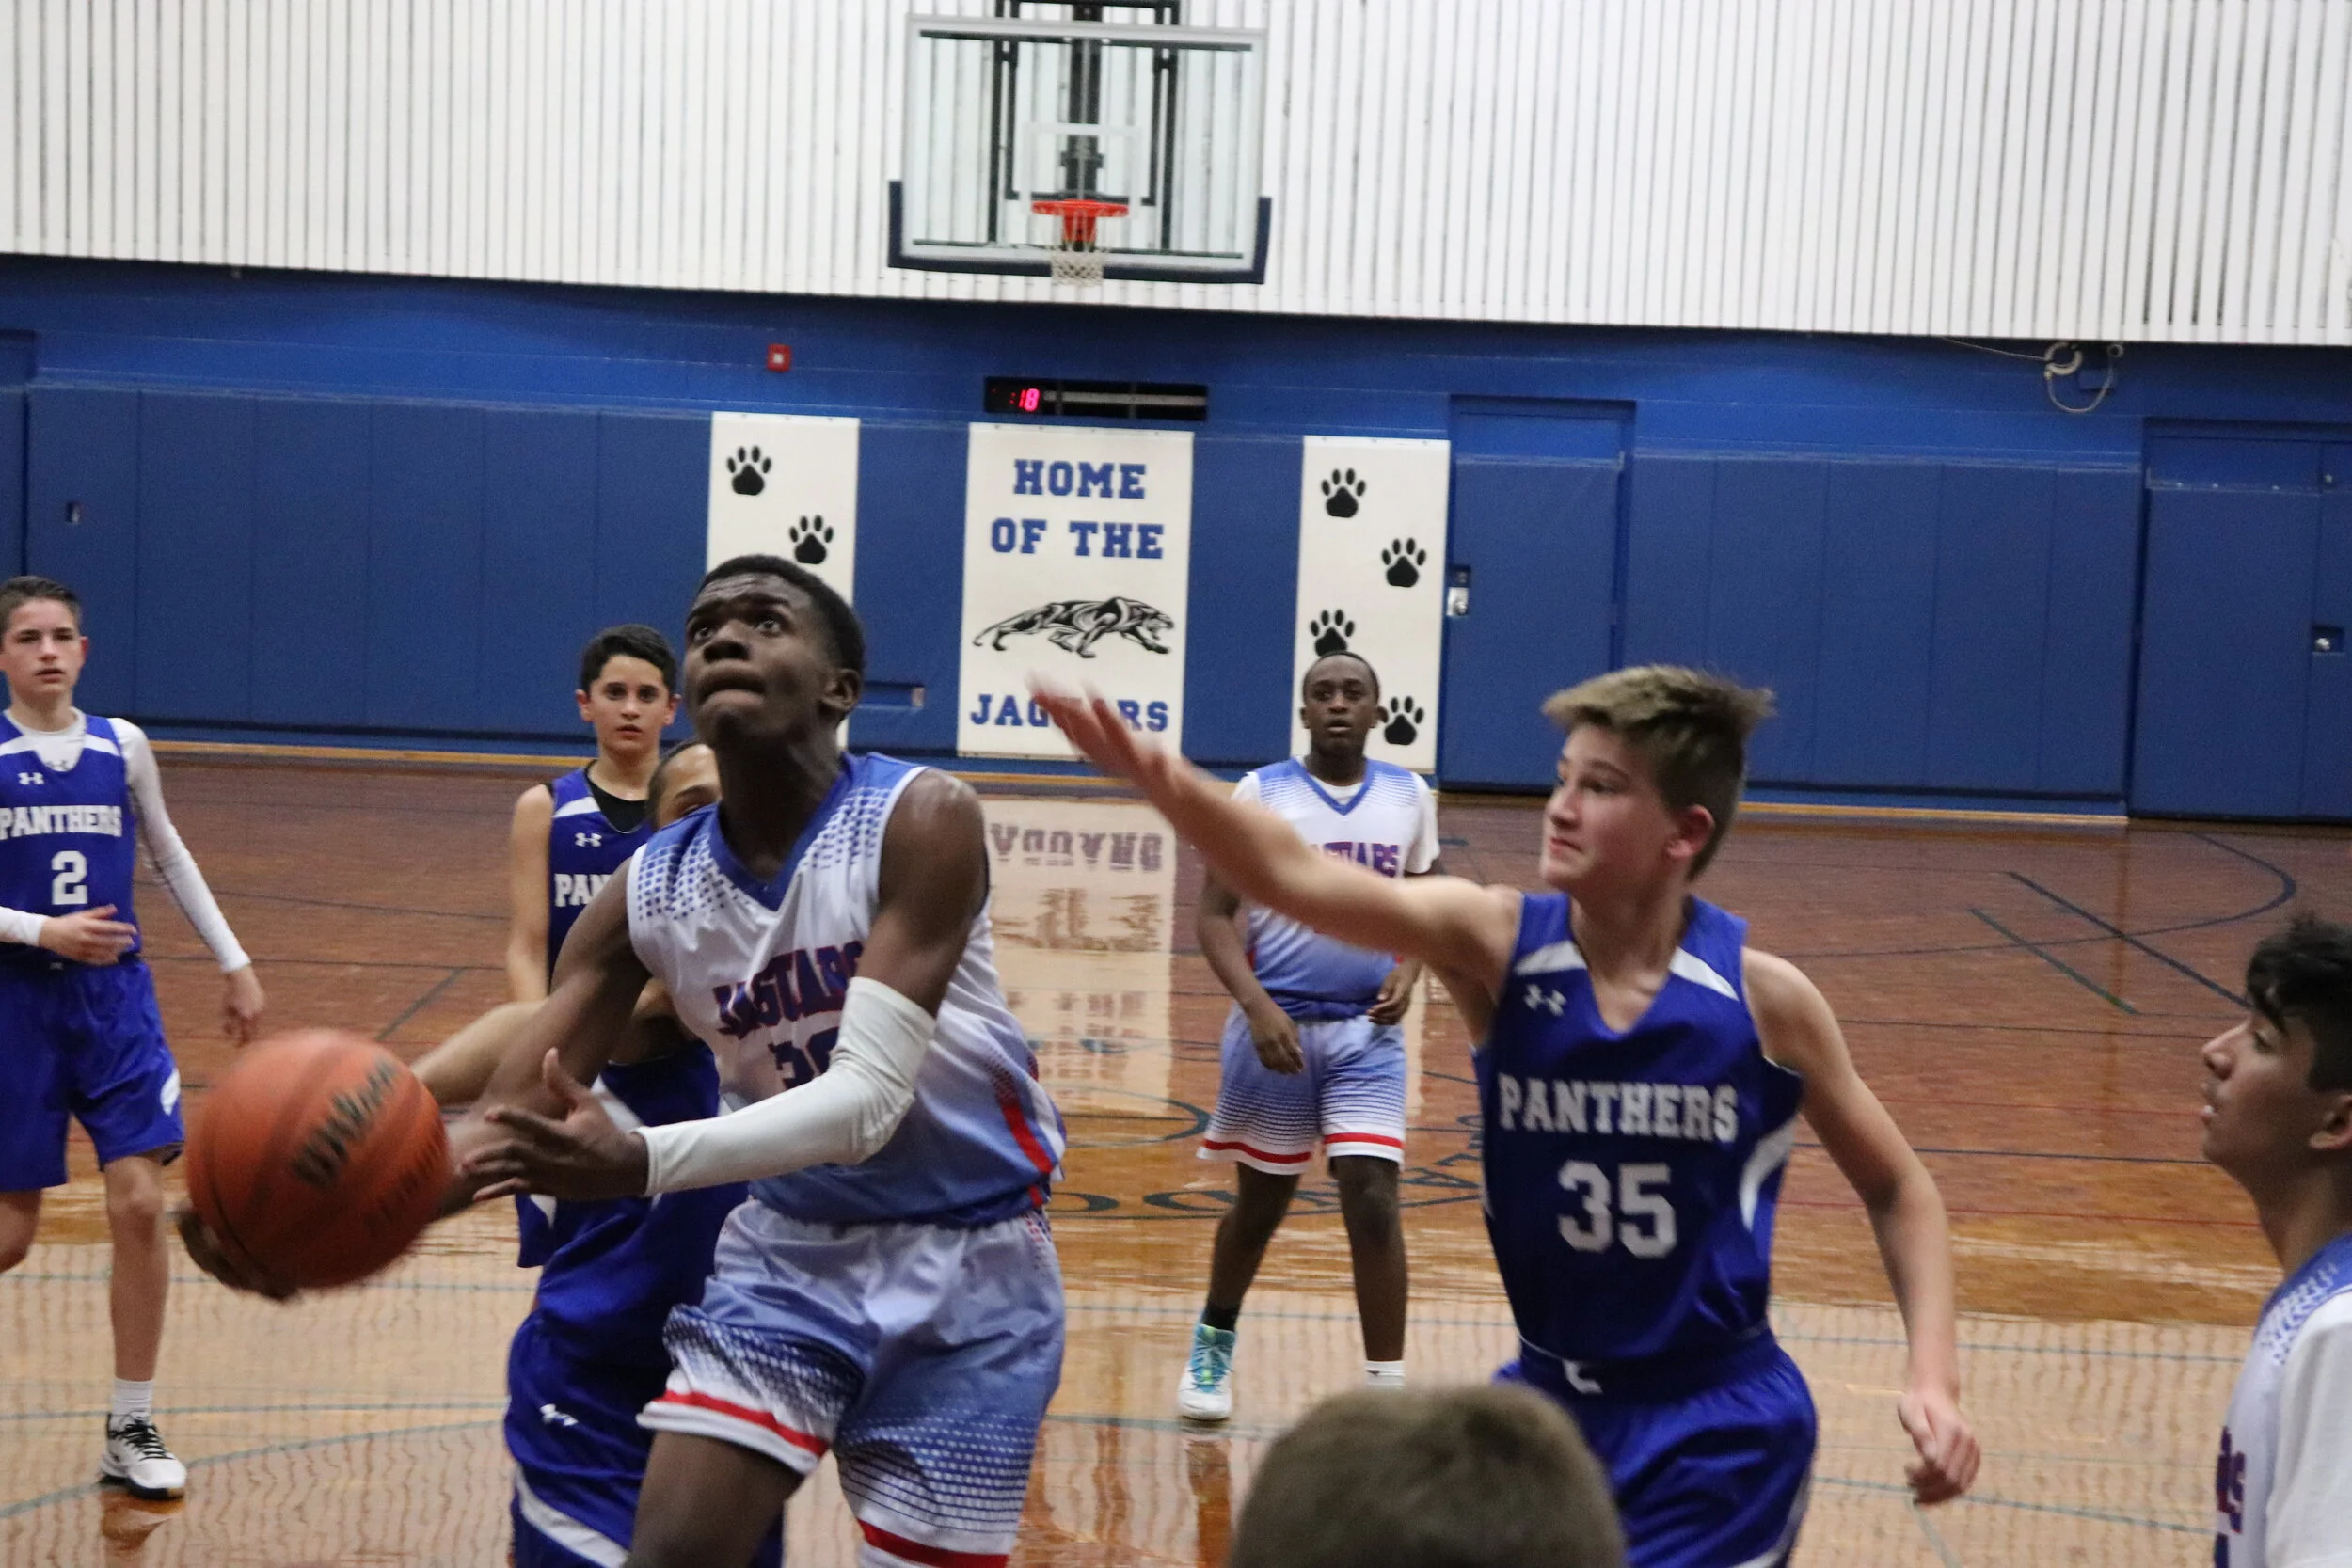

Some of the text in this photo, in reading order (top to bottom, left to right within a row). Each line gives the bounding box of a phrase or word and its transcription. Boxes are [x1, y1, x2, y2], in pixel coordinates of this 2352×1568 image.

[1013, 458, 1146, 499] HOME
[991, 517, 1164, 559] OF THE
[970, 693, 1168, 732] JAGRS
[51, 849, 87, 905] 2
[1497, 1072, 1739, 1144] PANTHERS
[1557, 1159, 1677, 1259] 35
